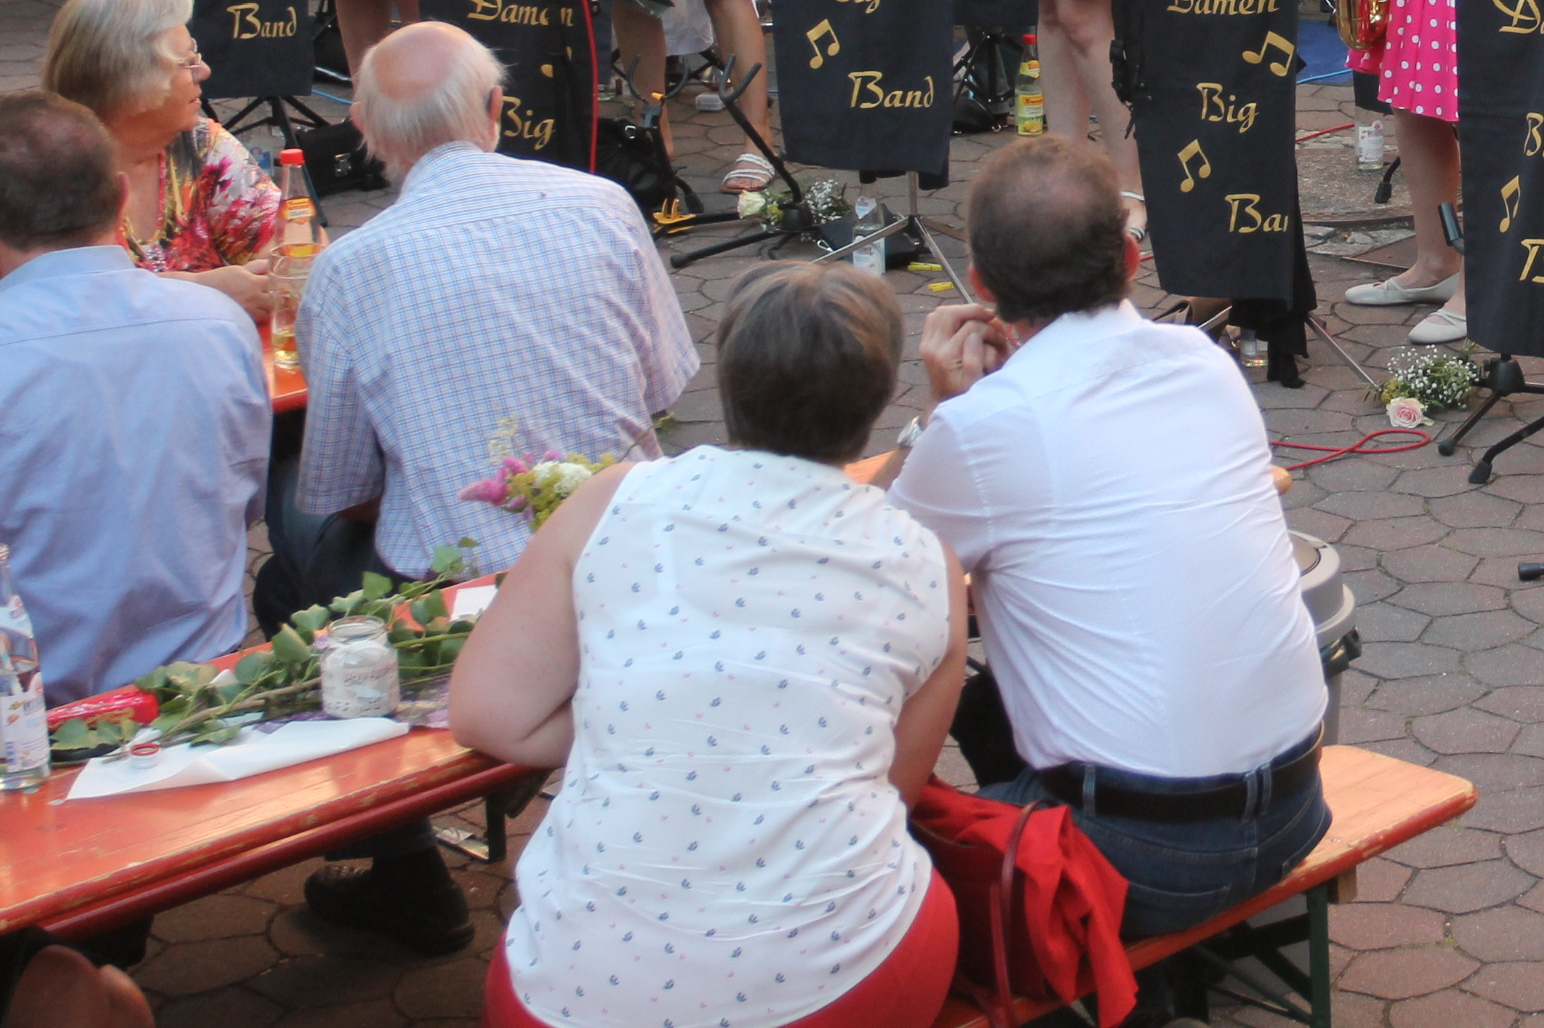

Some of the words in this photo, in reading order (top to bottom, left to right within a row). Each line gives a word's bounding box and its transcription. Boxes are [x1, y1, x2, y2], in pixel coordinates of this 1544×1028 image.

[226, 2, 298, 40] Band
[847, 70, 935, 109] Band
[1195, 82, 1259, 133] Big
